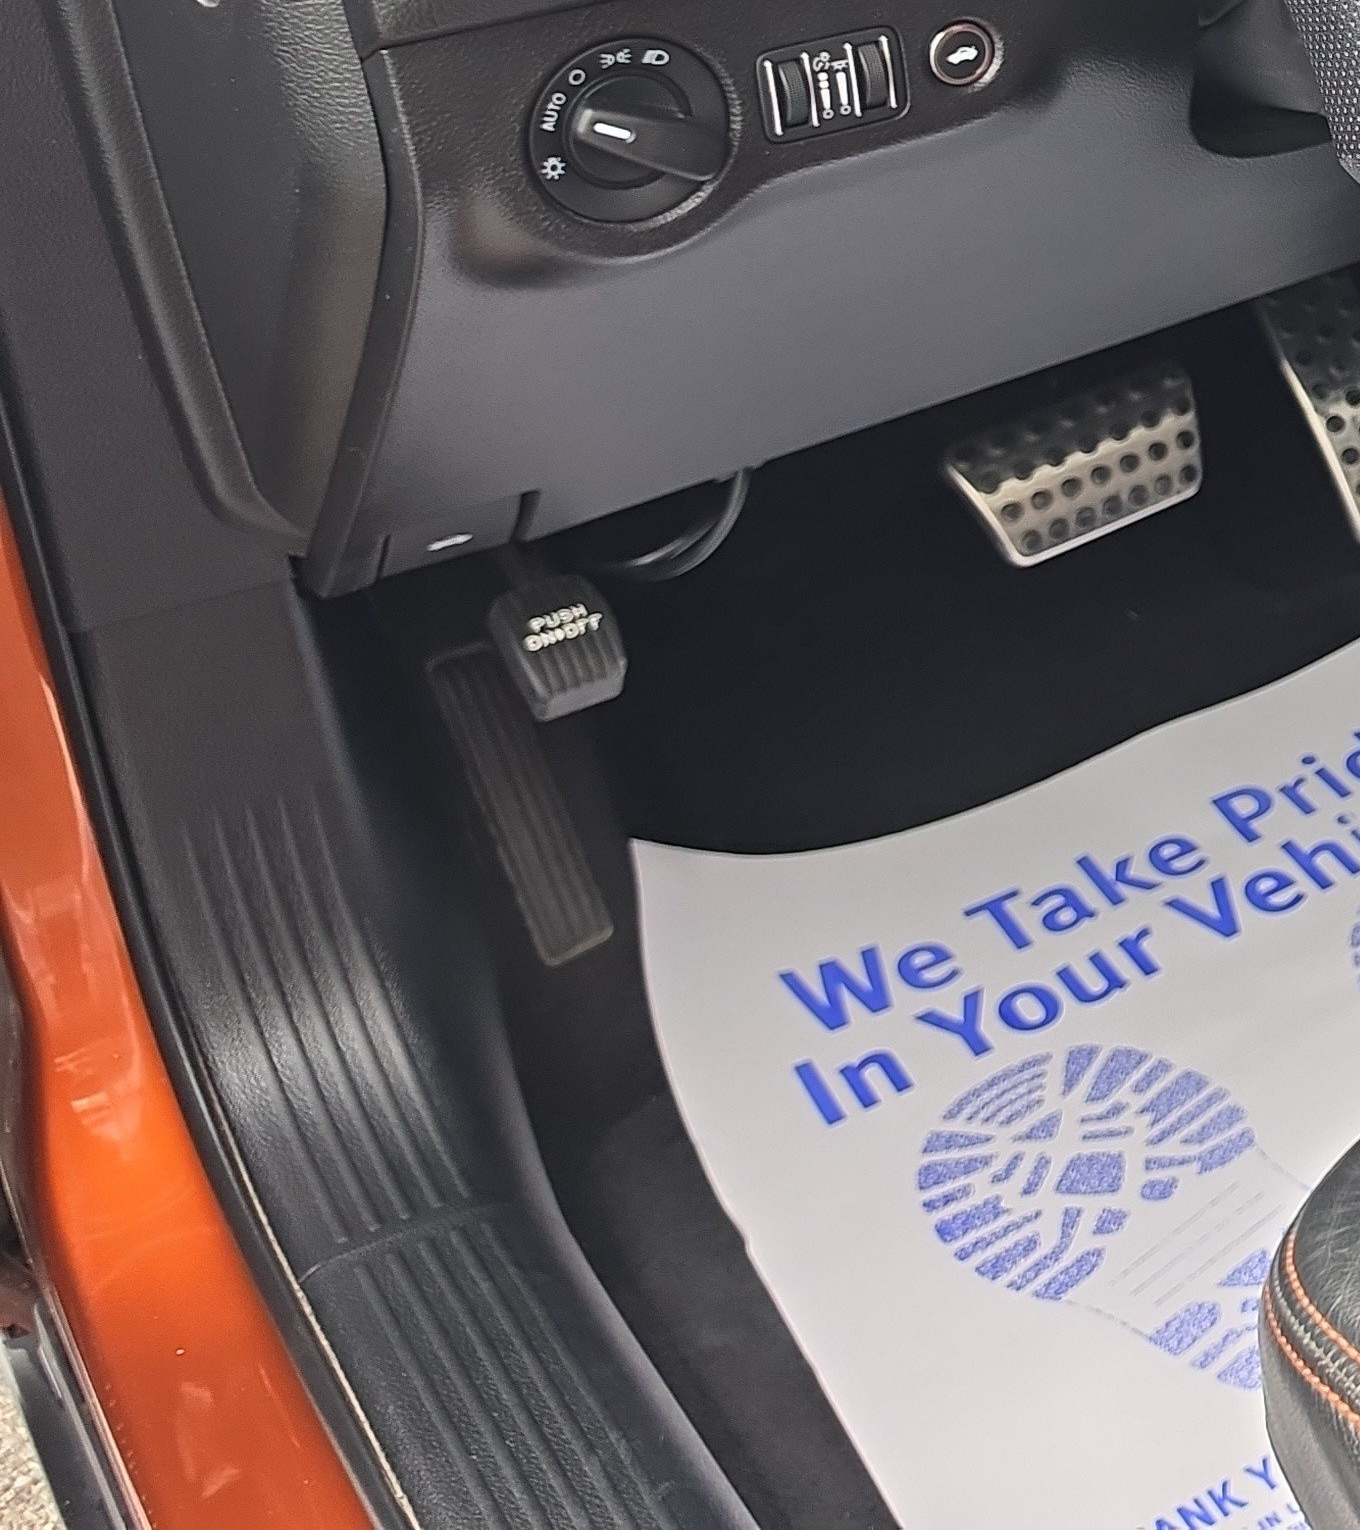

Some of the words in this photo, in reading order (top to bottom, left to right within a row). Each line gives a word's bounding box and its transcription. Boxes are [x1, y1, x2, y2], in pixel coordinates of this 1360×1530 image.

[540, 92, 567, 132] AUTO
[527, 603, 589, 633] PUSH
[779, 945, 958, 1032] We
[964, 836, 1208, 950] Take
[793, 1052, 913, 1127] In
[917, 923, 1162, 1058] Your
